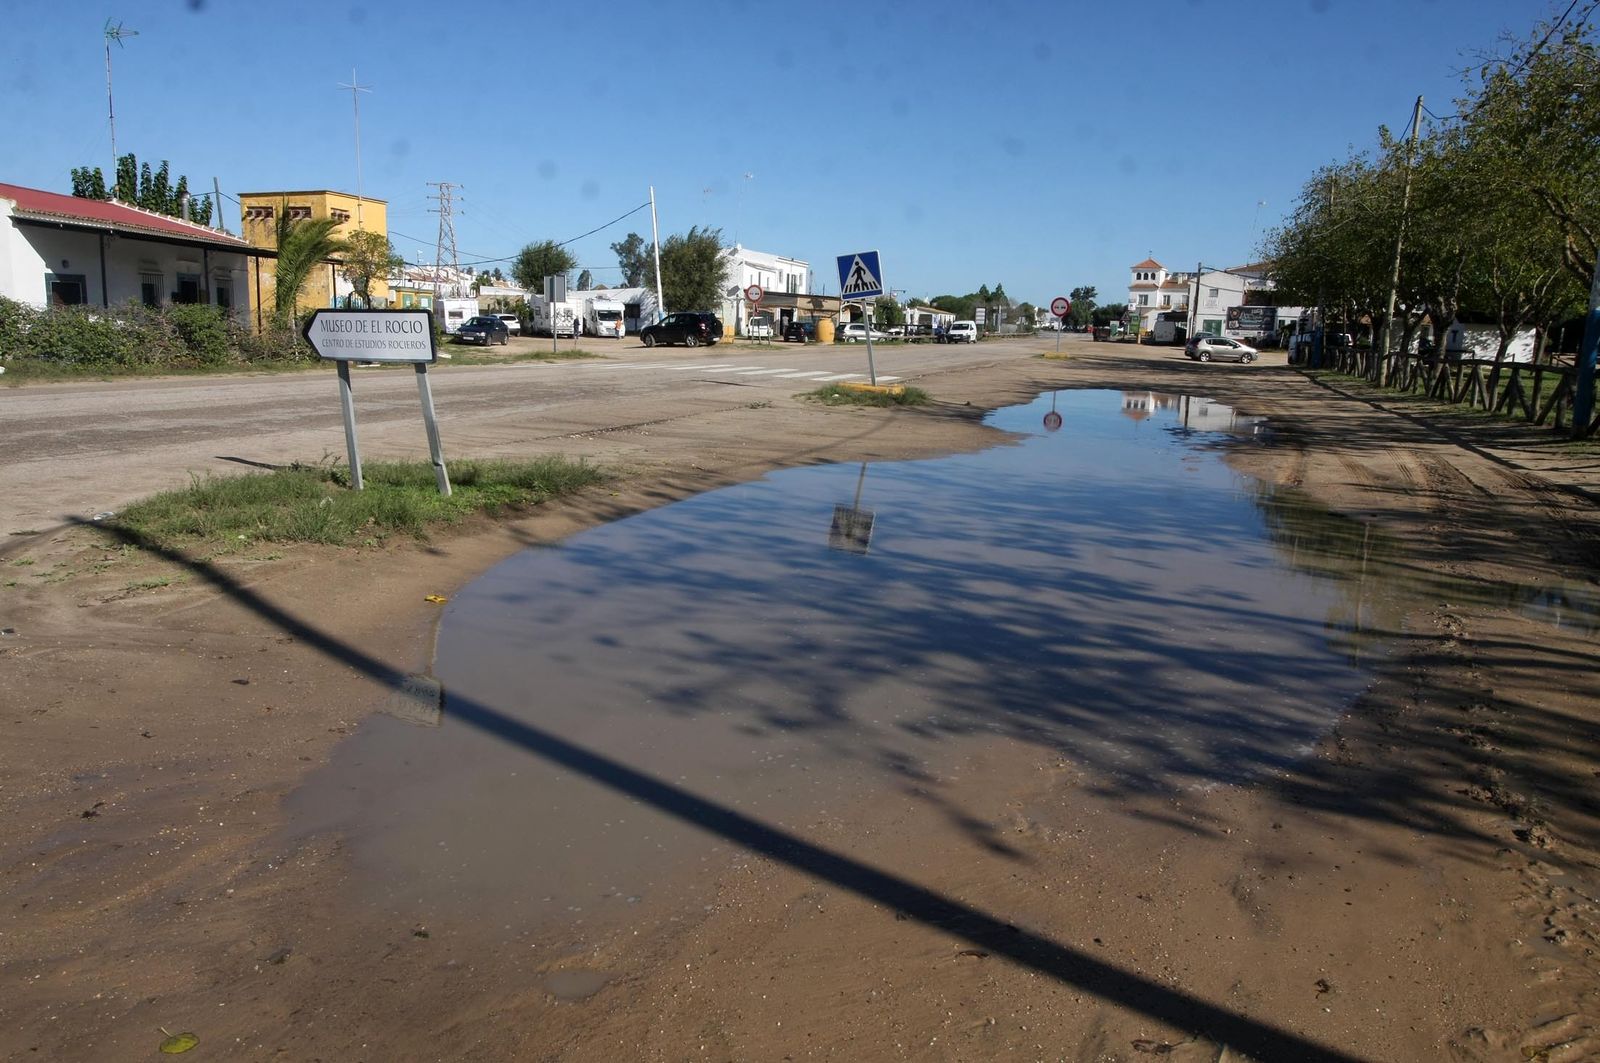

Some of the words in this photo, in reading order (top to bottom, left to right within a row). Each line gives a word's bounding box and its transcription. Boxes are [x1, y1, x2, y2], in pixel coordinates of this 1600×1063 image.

[320, 319, 352, 333] MUSEO
[355, 319, 368, 333] DE
[371, 320, 382, 333] EL
[385, 320, 423, 334] ROCIO
[321, 339, 344, 348] CENTRO
[345, 339, 354, 349] DE
[355, 340, 386, 349] ESTUDIOS
[388, 340, 427, 350] ROCIEROS
